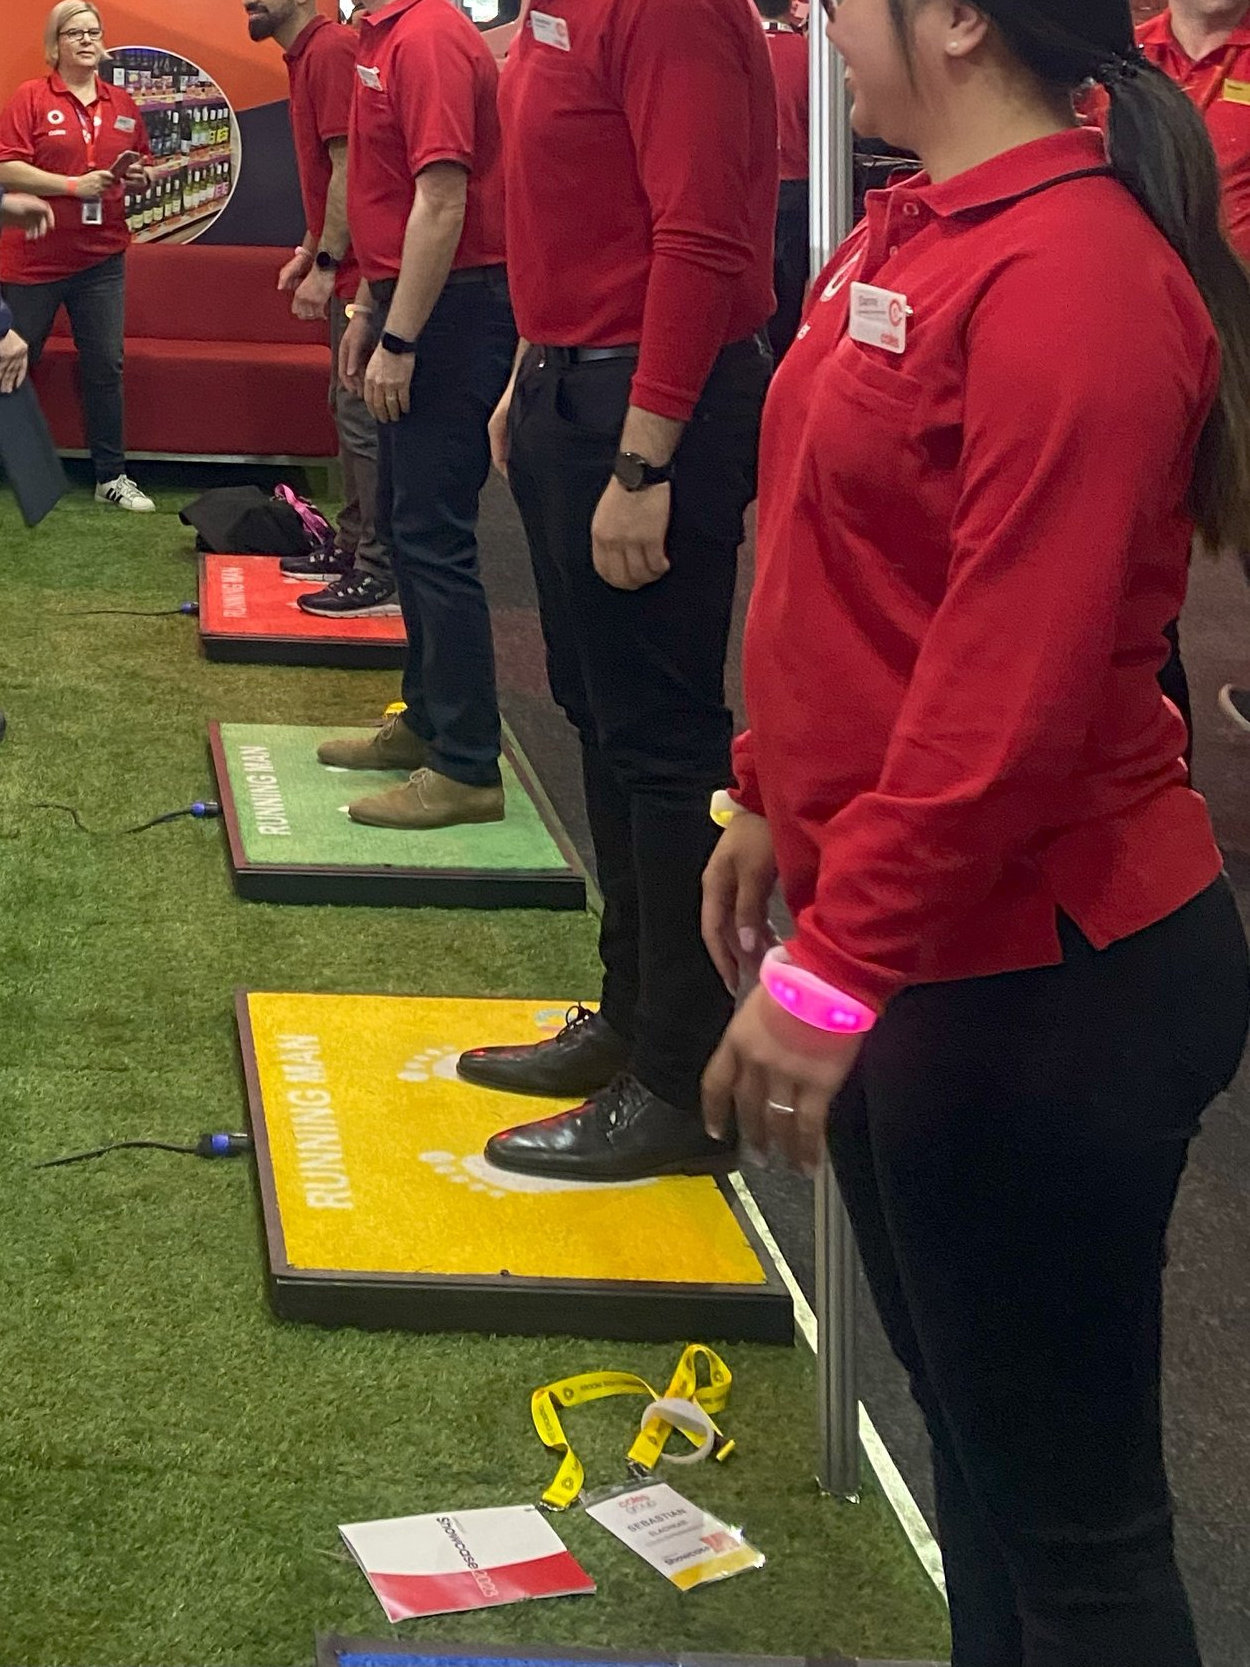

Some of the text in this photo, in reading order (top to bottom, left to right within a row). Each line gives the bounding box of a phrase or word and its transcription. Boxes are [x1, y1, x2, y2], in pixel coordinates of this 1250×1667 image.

[221, 566, 246, 619] RUNNING MAN
[239, 745, 290, 835] RUNNING MAN
[276, 1034, 353, 1211] RUNNING MAN
[436, 1517, 499, 1597] Showcase 2023
[627, 1508, 687, 1532] SEBASTIAN
